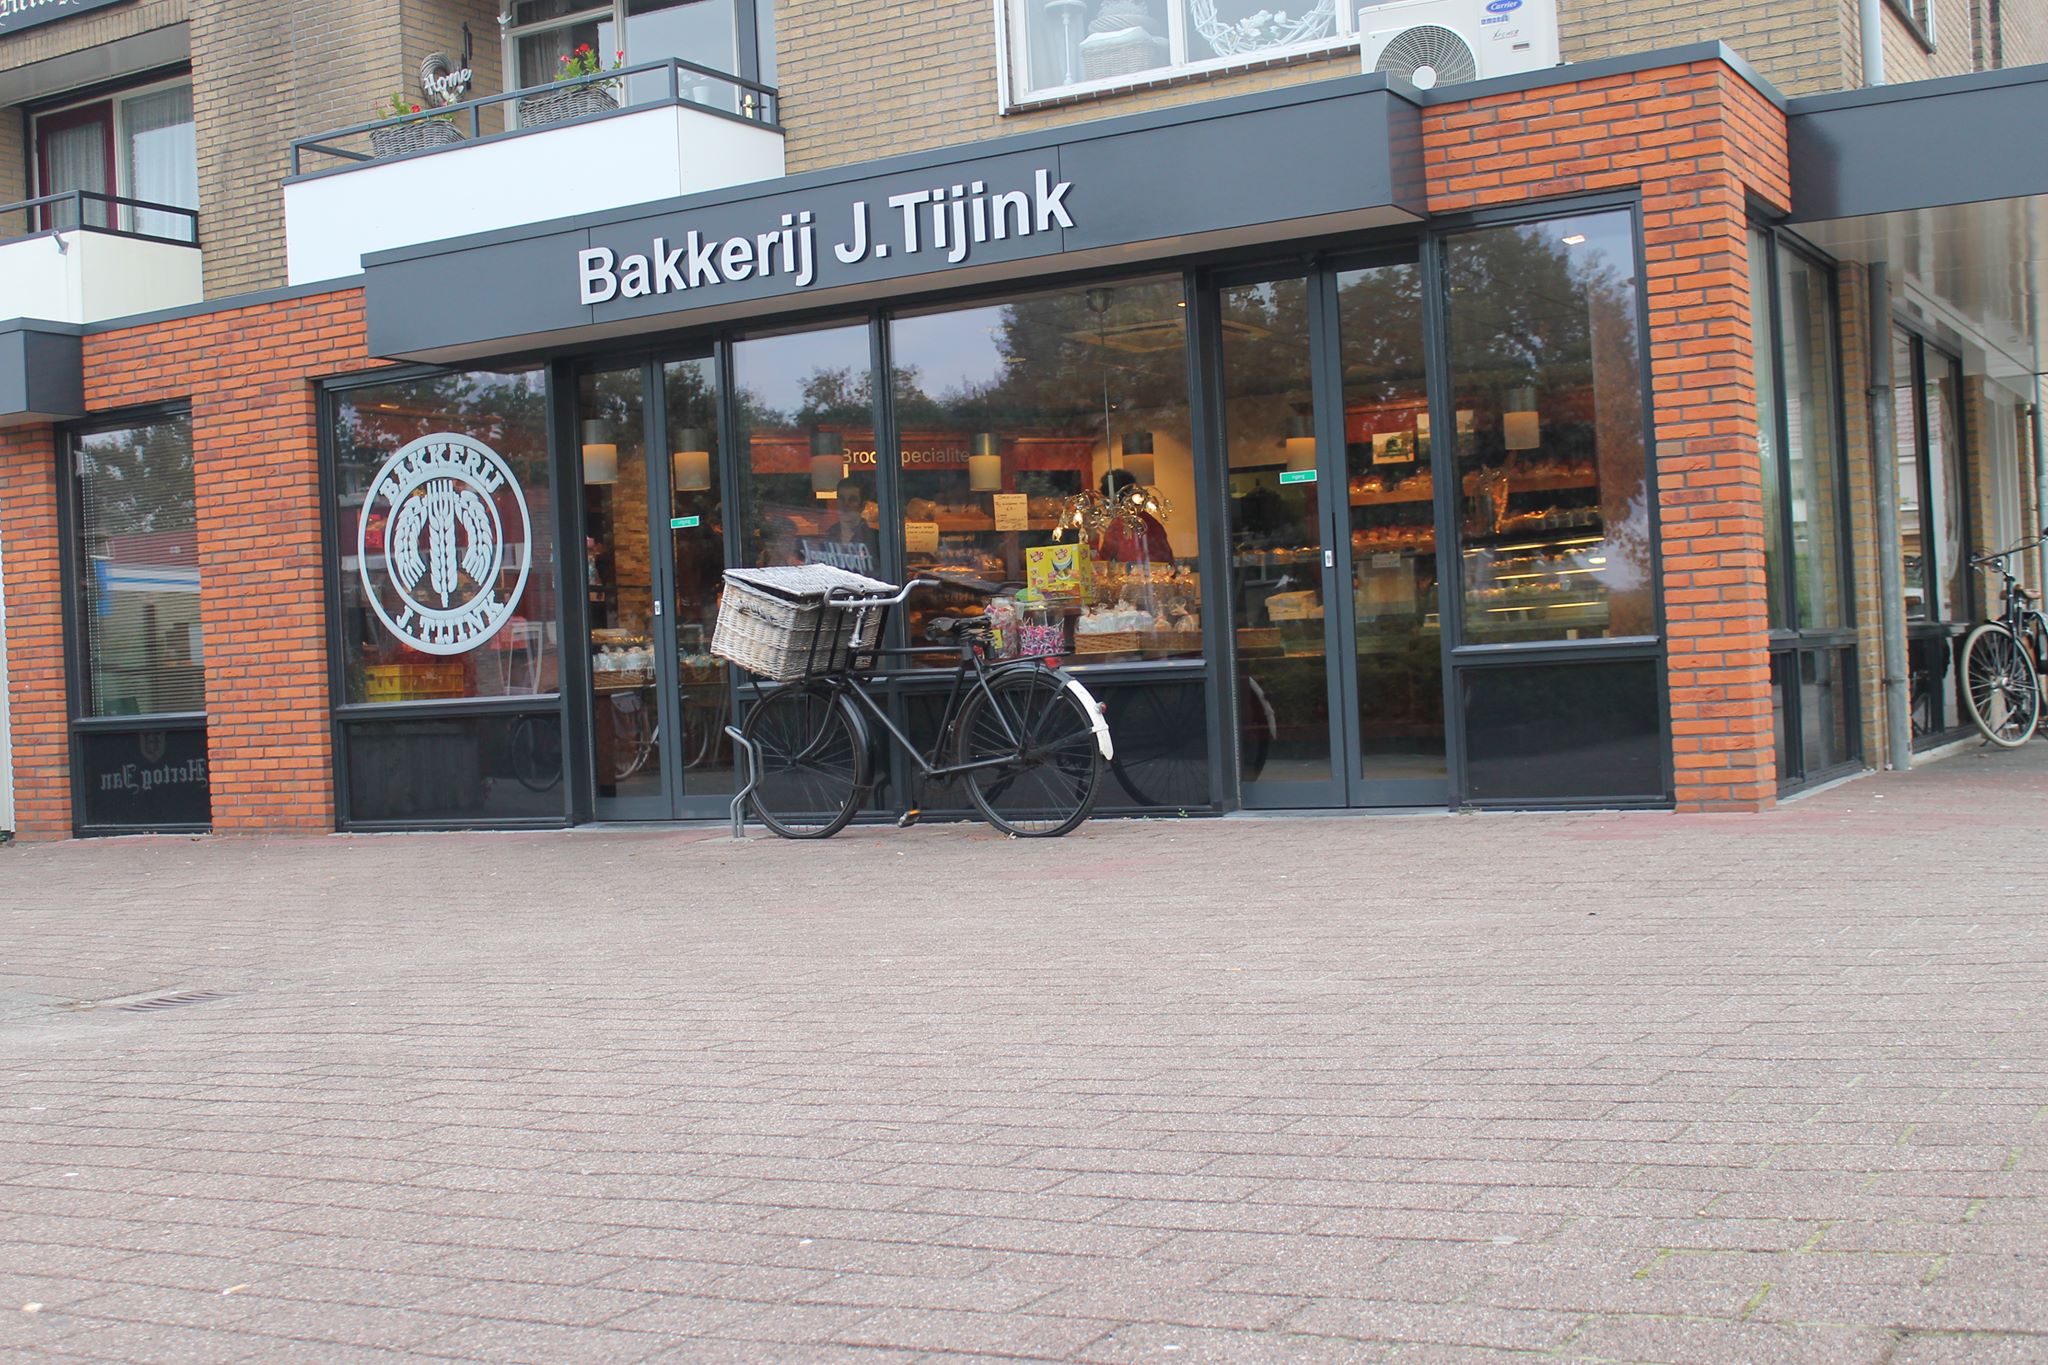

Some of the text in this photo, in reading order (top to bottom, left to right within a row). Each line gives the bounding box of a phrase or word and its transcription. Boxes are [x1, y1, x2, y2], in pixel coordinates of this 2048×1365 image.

[1490, 1, 1518, 11] Carrier
[423, 68, 472, 95] Home
[578, 210, 814, 305] Bakkerij
[379, 443, 504, 506] BAKKERIJ
[419, 590, 505, 645] TIJINK
